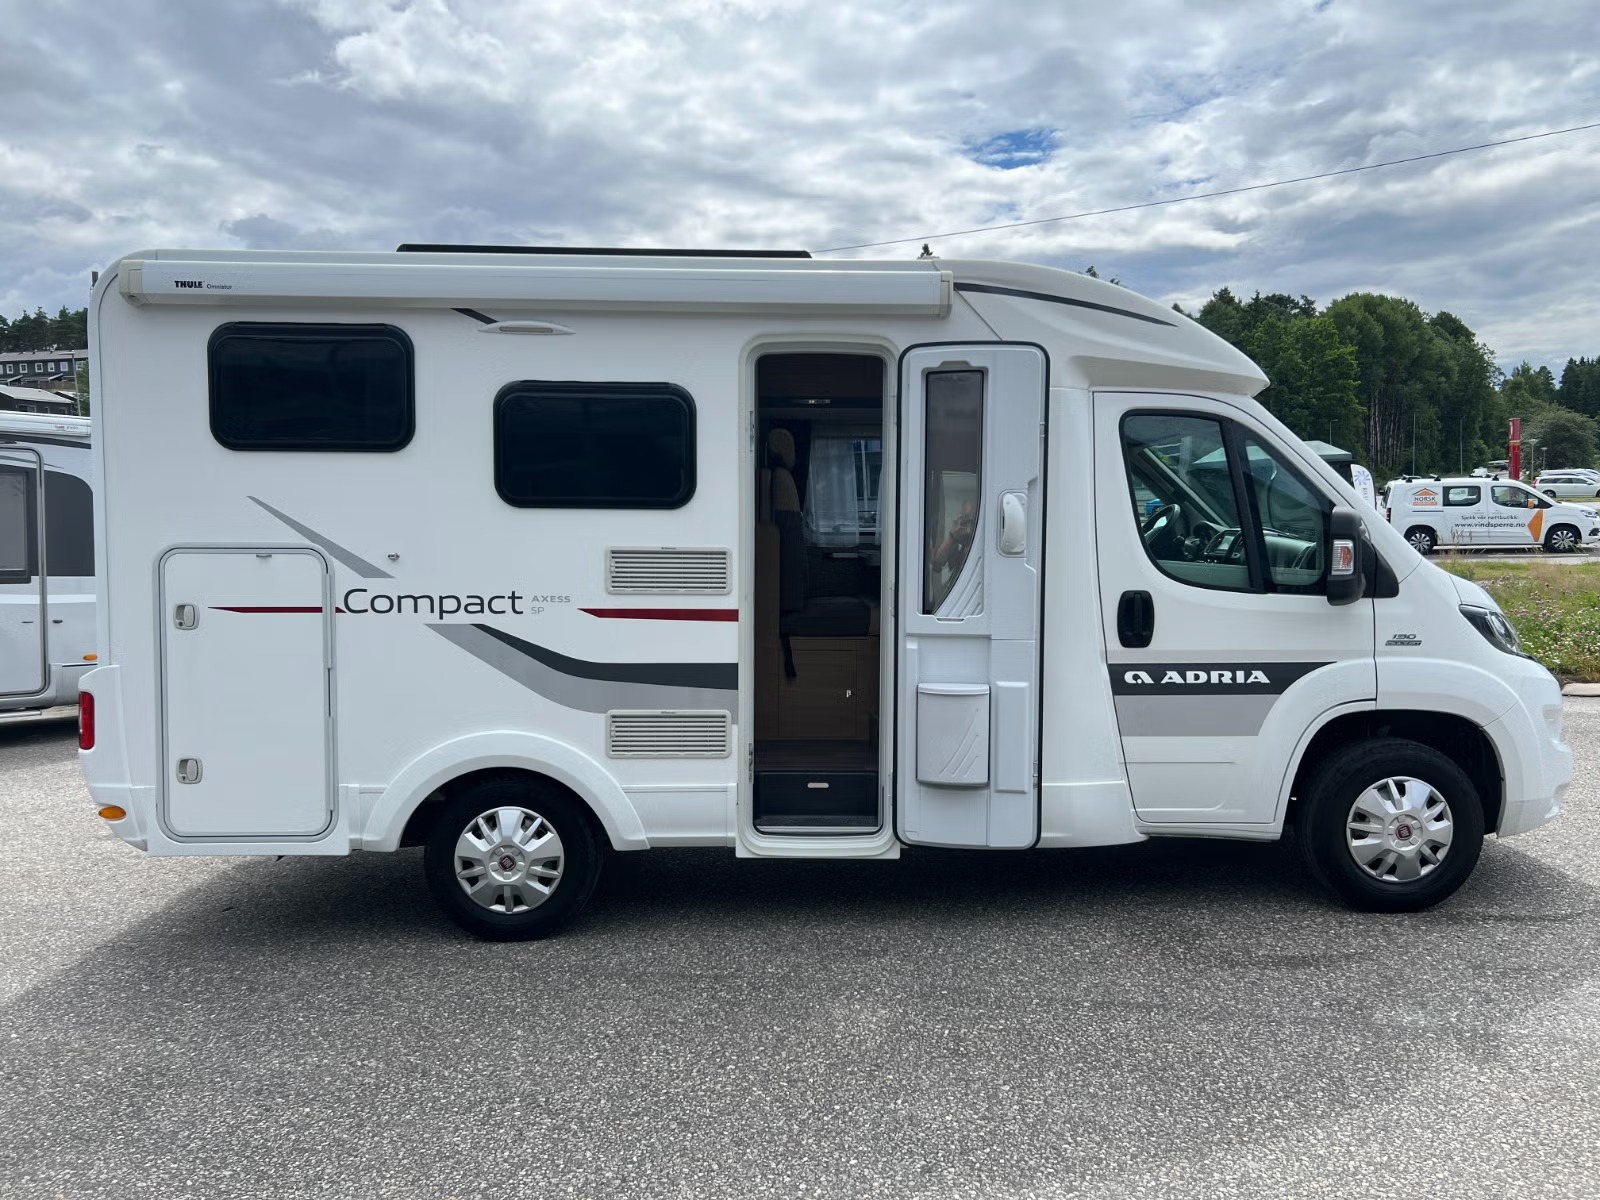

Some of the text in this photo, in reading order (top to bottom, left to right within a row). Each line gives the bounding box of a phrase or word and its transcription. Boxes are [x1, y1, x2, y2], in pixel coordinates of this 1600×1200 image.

[174, 280, 203, 289] THULE
[531, 595, 571, 603] AXESS
[343, 588, 524, 620] Compact
[531, 606, 545, 615] SP
[1160, 670, 1271, 684] ADRIA
